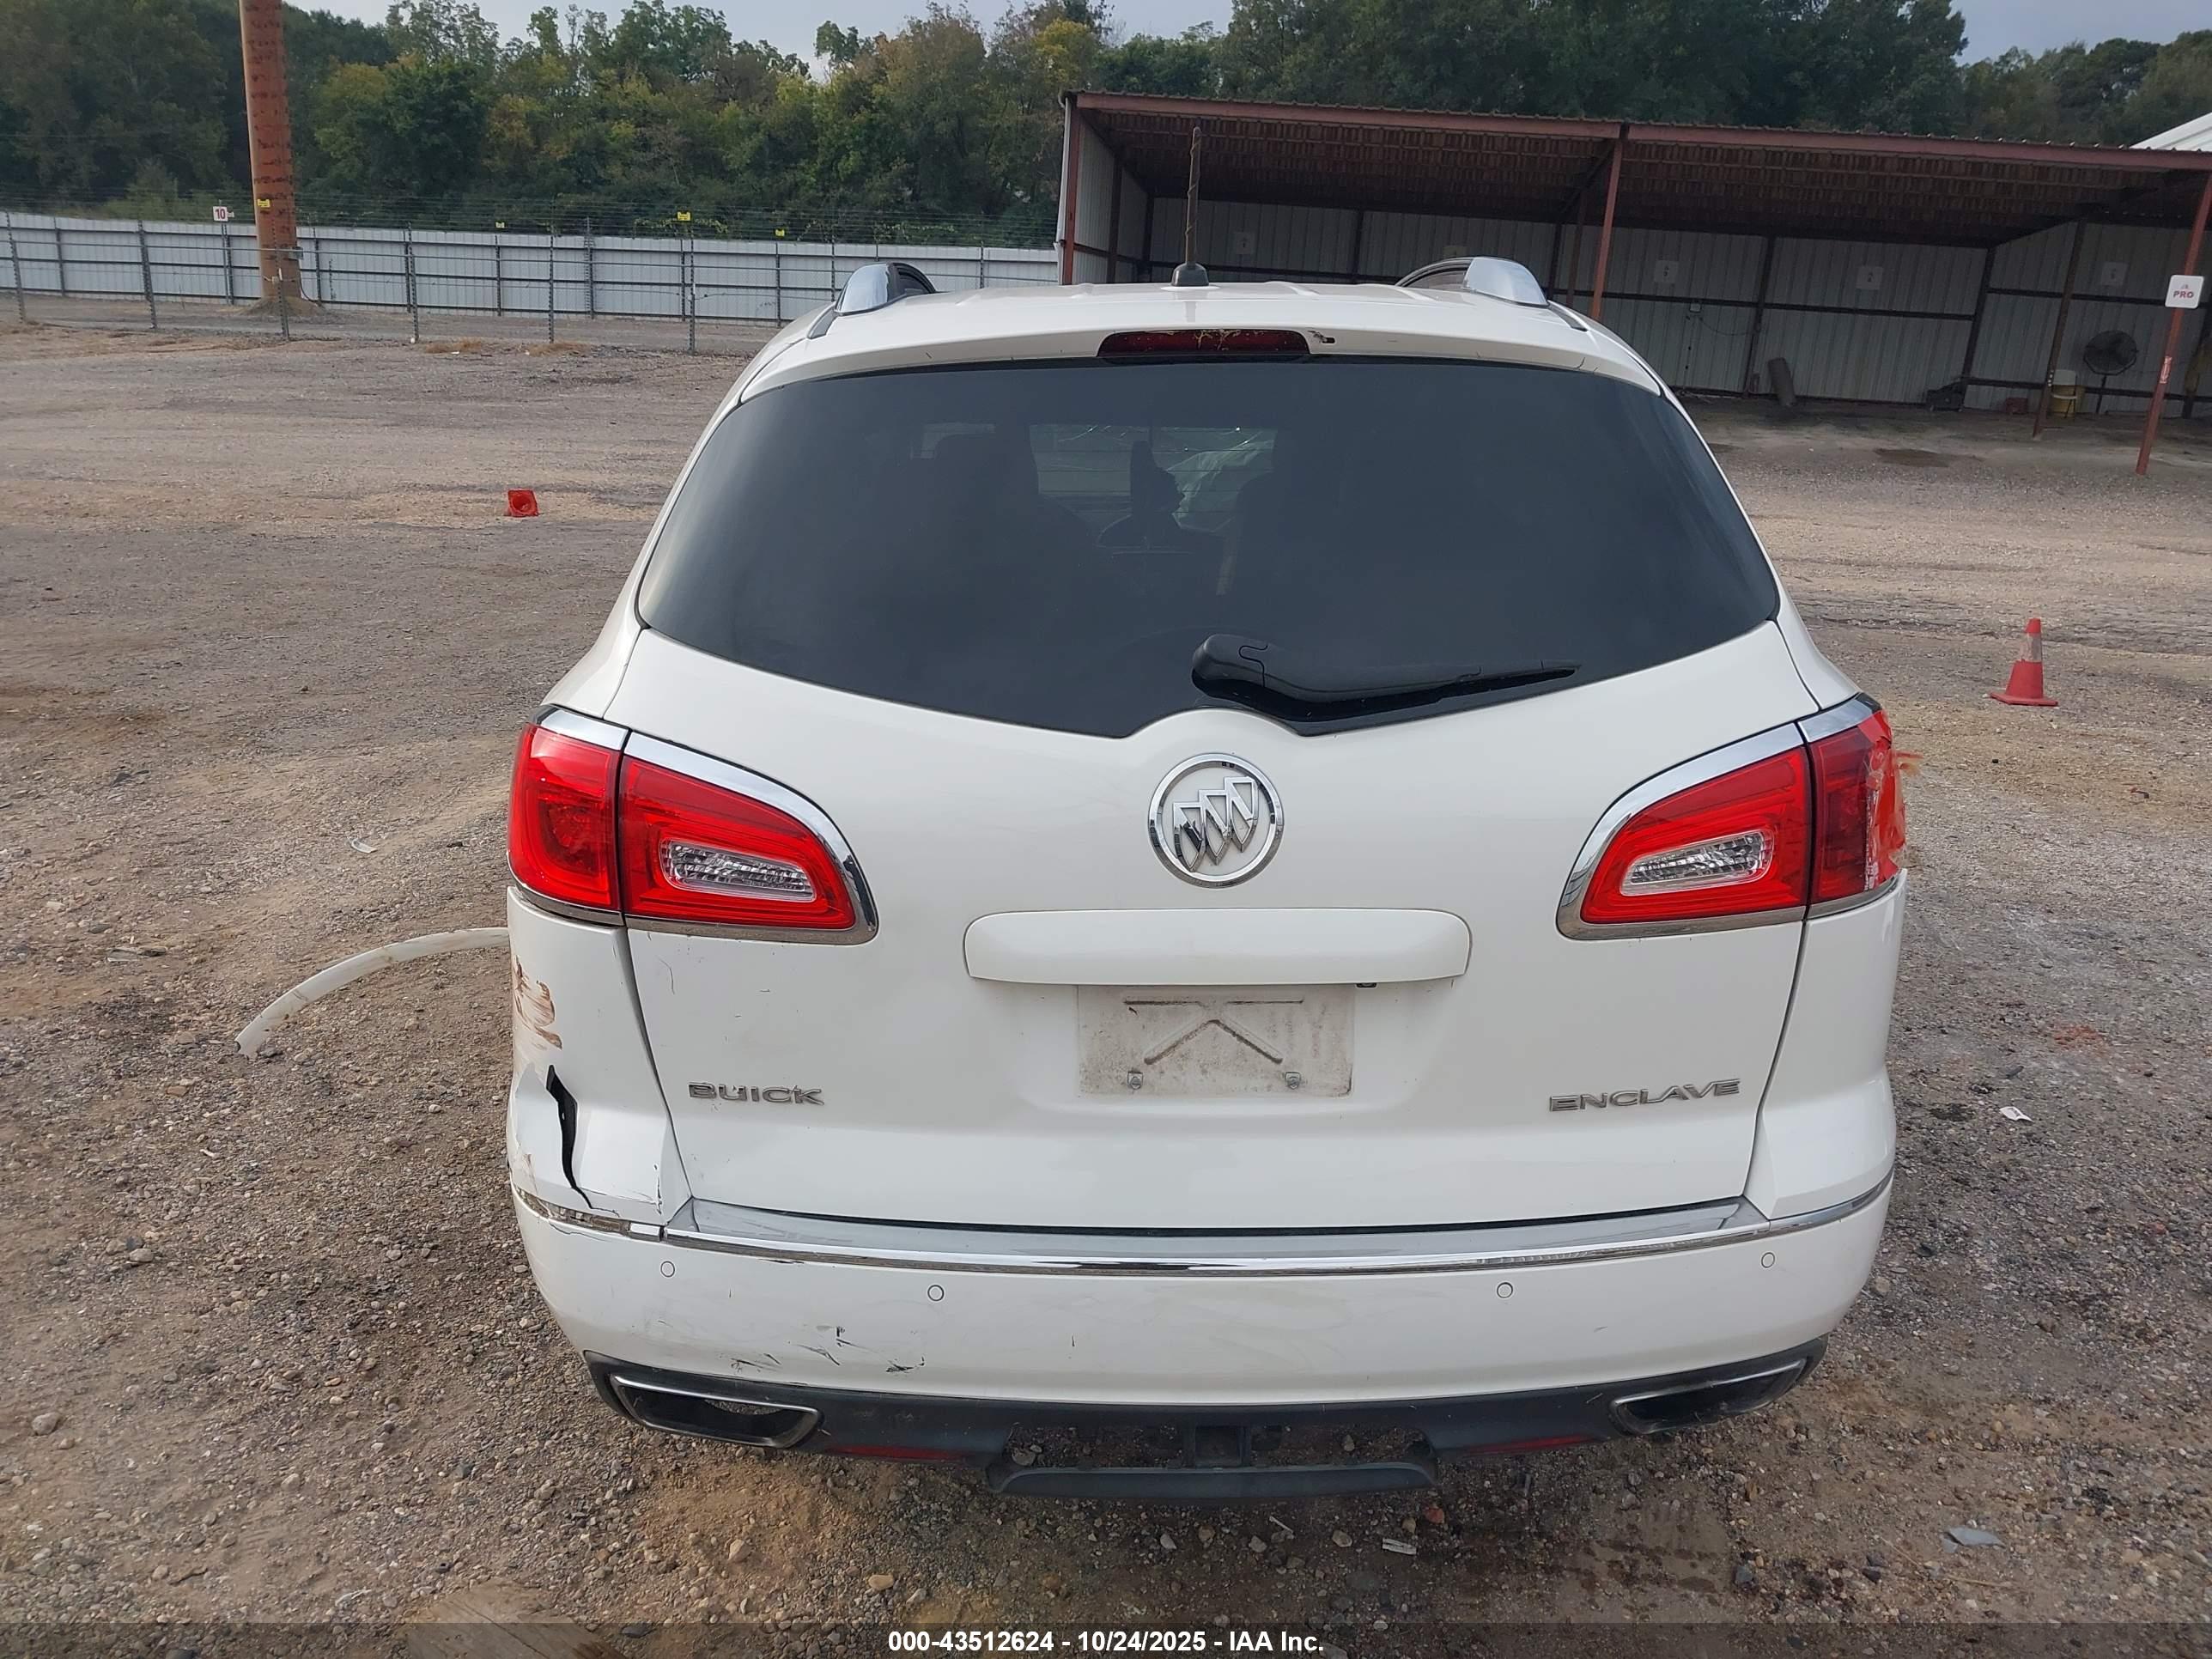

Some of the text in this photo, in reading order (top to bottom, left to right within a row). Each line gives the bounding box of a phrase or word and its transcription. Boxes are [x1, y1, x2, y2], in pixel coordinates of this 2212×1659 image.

[215, 208, 226, 219] 10
[2172, 290, 2195, 299] PRO
[687, 1081, 824, 1106] BUICK
[1549, 1078, 1741, 1112] ENCLAVE
